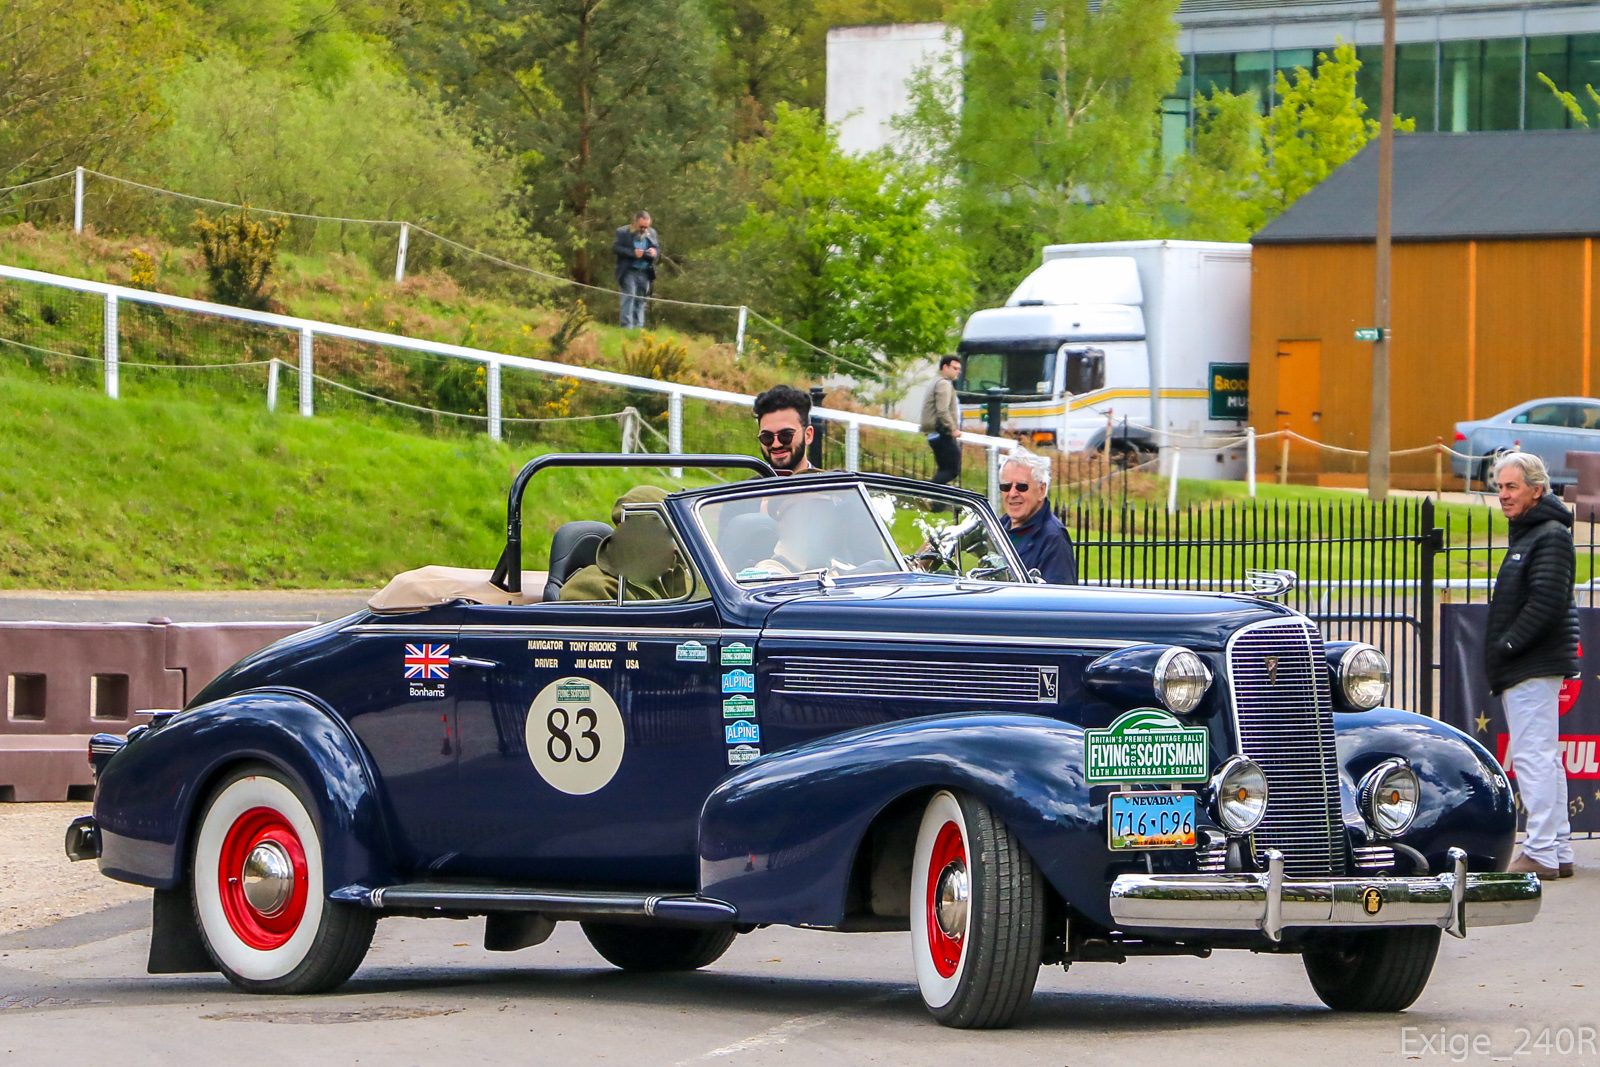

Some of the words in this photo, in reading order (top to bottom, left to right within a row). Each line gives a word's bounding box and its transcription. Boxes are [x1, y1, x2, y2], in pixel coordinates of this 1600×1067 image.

[528, 640, 564, 650] NAVIGATOR
[570, 642, 588, 651] TONY
[588, 642, 616, 652] BROOKS
[627, 642, 638, 651] UK
[534, 658, 558, 668] DRIVER
[574, 659, 586, 669] JIM
[588, 659, 612, 669] GATELY
[626, 660, 639, 669] USA
[724, 676, 752, 689] ALPINE
[410, 687, 445, 697] Bonhams
[547, 708, 601, 763] 83
[728, 726, 757, 740] ALPINE
[1091, 743, 1130, 767] FLYING
[1137, 742, 1203, 767] SCOTSMAN
[1113, 767, 1167, 776] ANNIVERSARY
[1171, 766, 1203, 775] EDITION
[1494, 774, 1506, 788] 83
[1132, 796, 1174, 806] NEVADA
